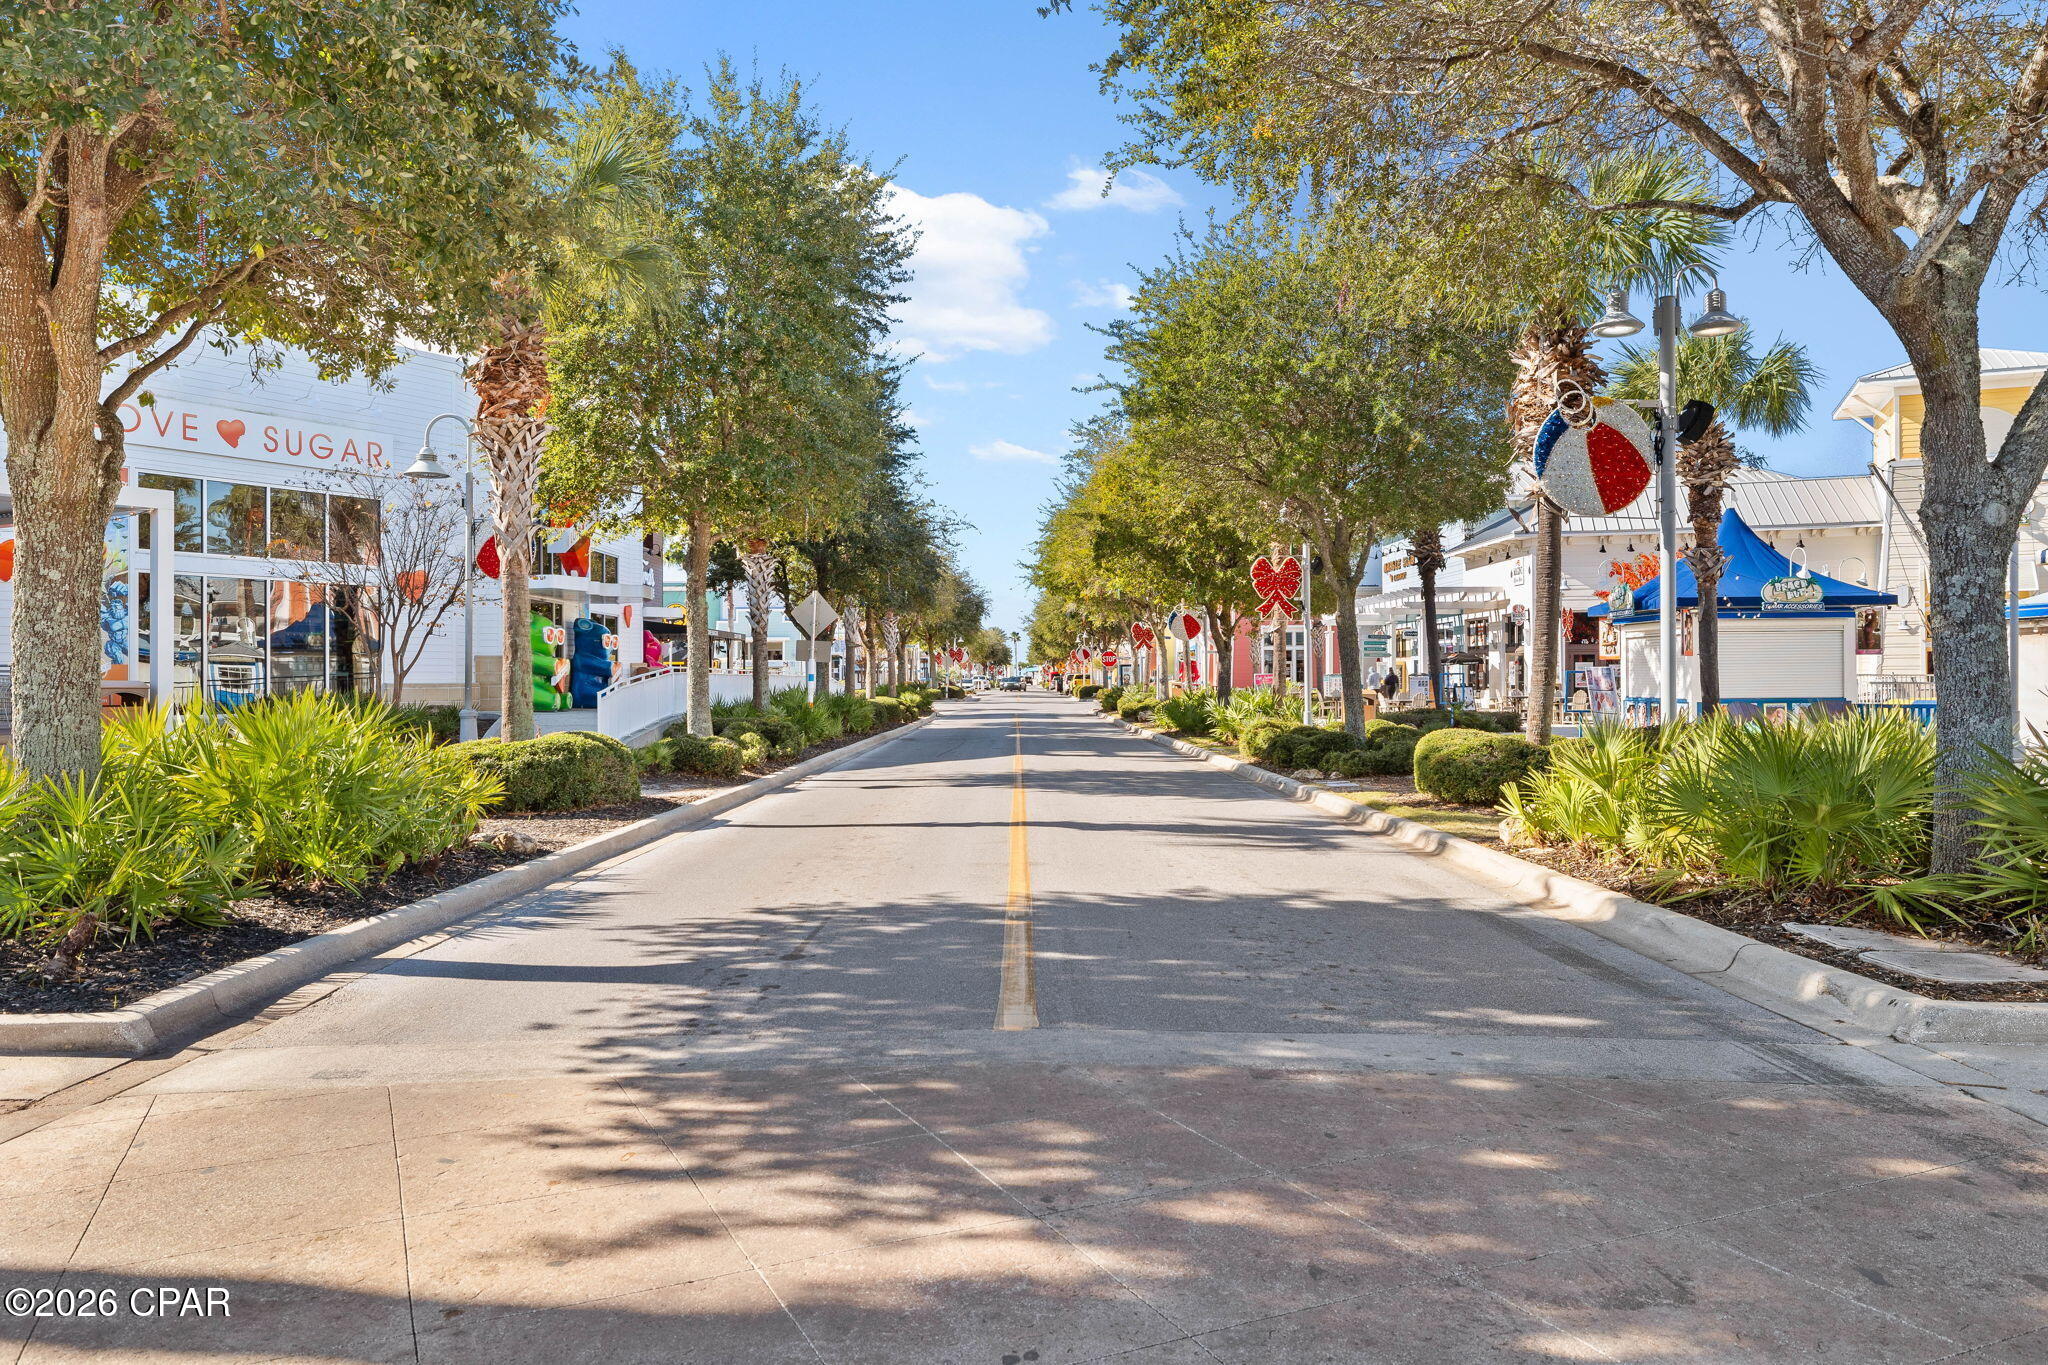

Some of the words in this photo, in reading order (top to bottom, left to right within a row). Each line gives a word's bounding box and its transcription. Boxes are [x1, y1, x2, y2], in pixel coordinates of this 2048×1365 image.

[119, 403, 198, 442] OVE
[263, 425, 383, 467] SUGAR
[1774, 579, 1808, 592] BEACH
[1786, 588, 1805, 600] HUT
